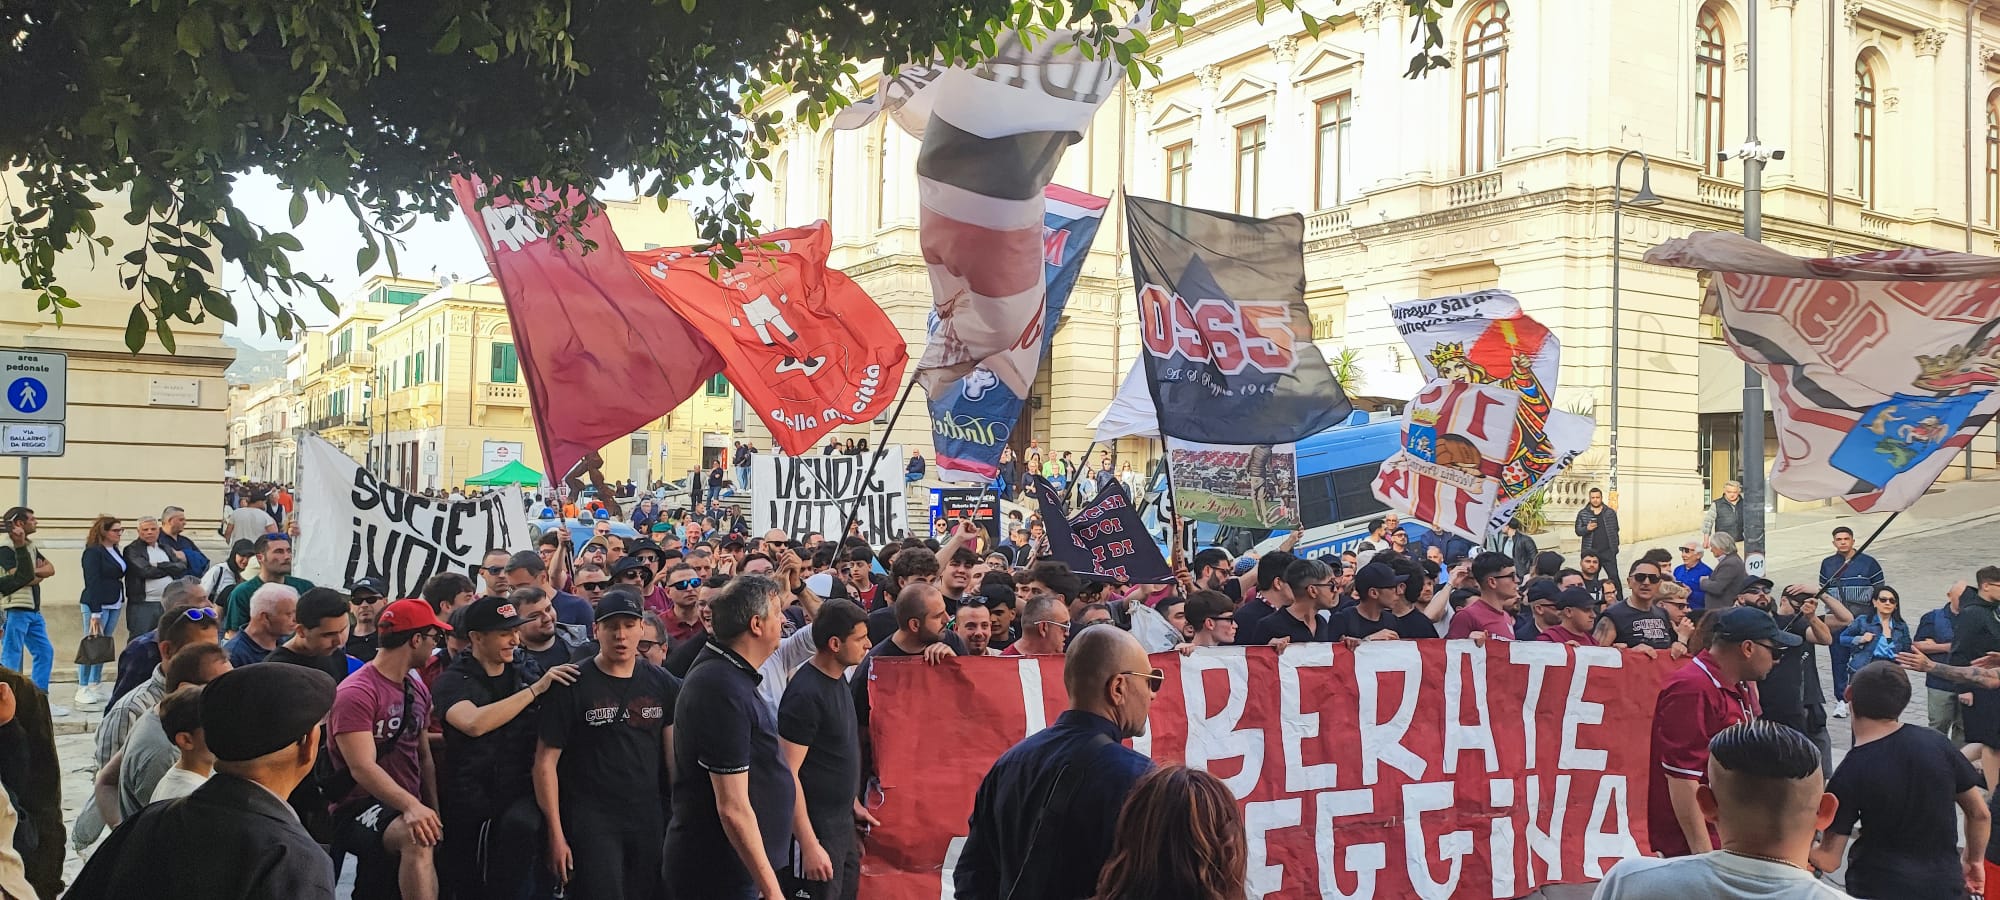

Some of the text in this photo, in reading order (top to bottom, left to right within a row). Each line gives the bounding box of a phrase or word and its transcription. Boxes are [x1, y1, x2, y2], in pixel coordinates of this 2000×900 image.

[1139, 282, 1299, 375] 0965
[6, 363, 50, 373] pedonale
[770, 407, 818, 432] della
[1749, 559, 1764, 570] 101
